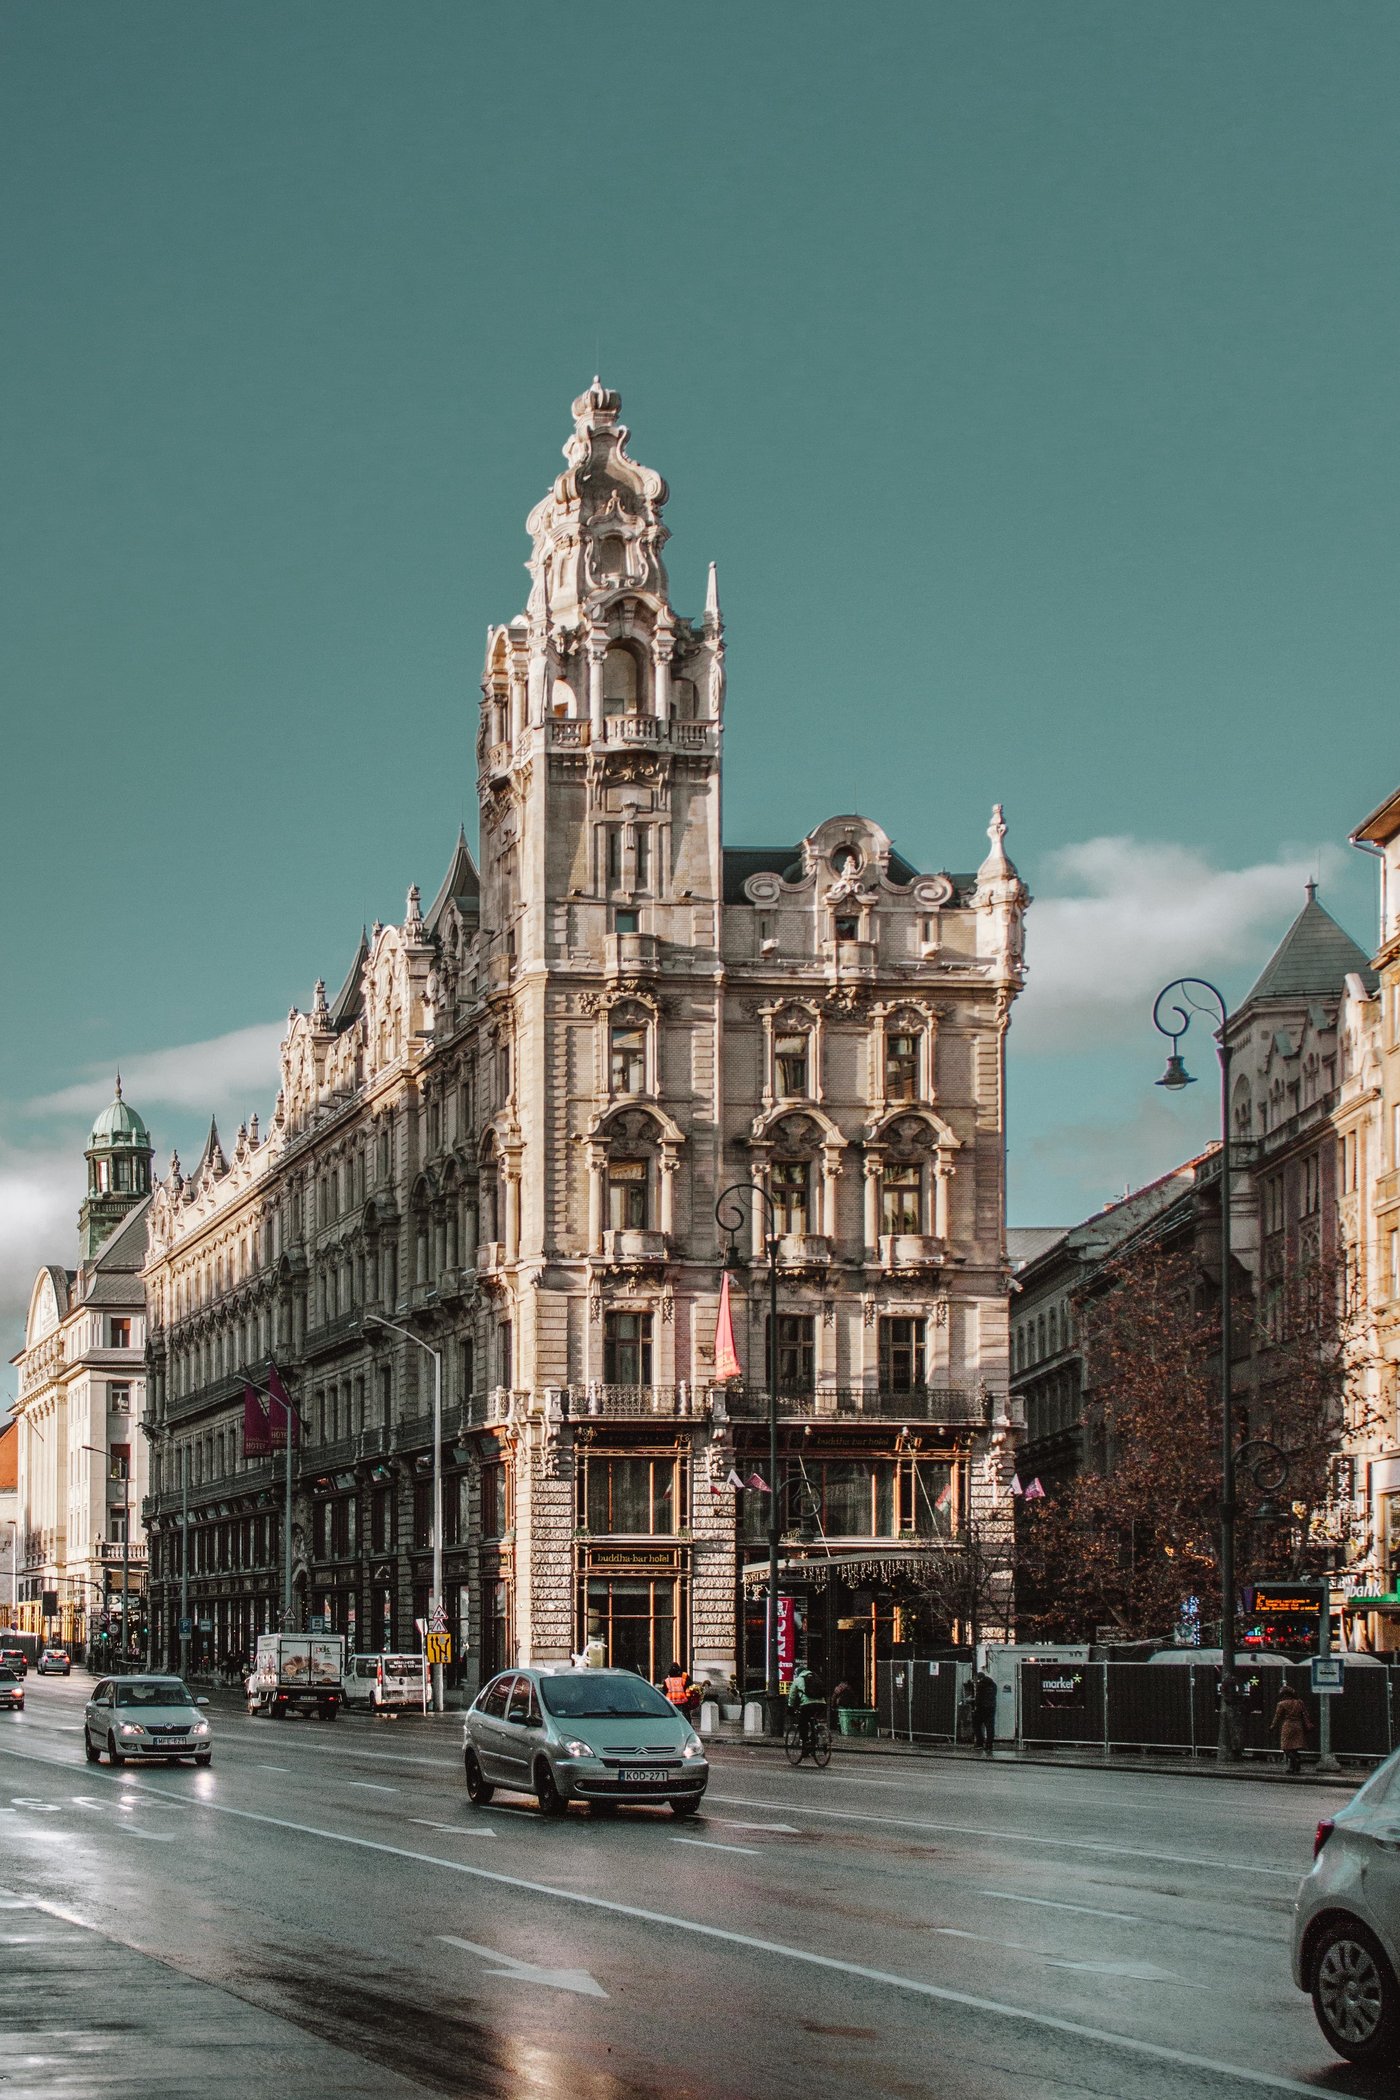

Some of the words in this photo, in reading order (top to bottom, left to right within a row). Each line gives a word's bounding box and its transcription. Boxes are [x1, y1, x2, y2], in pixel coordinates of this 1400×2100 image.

[597, 1553, 648, 1563] buddha-bar
[648, 1553, 670, 1563] hotel
[1042, 1676, 1074, 1689] market
[626, 1771, 665, 1780] KOD-271
